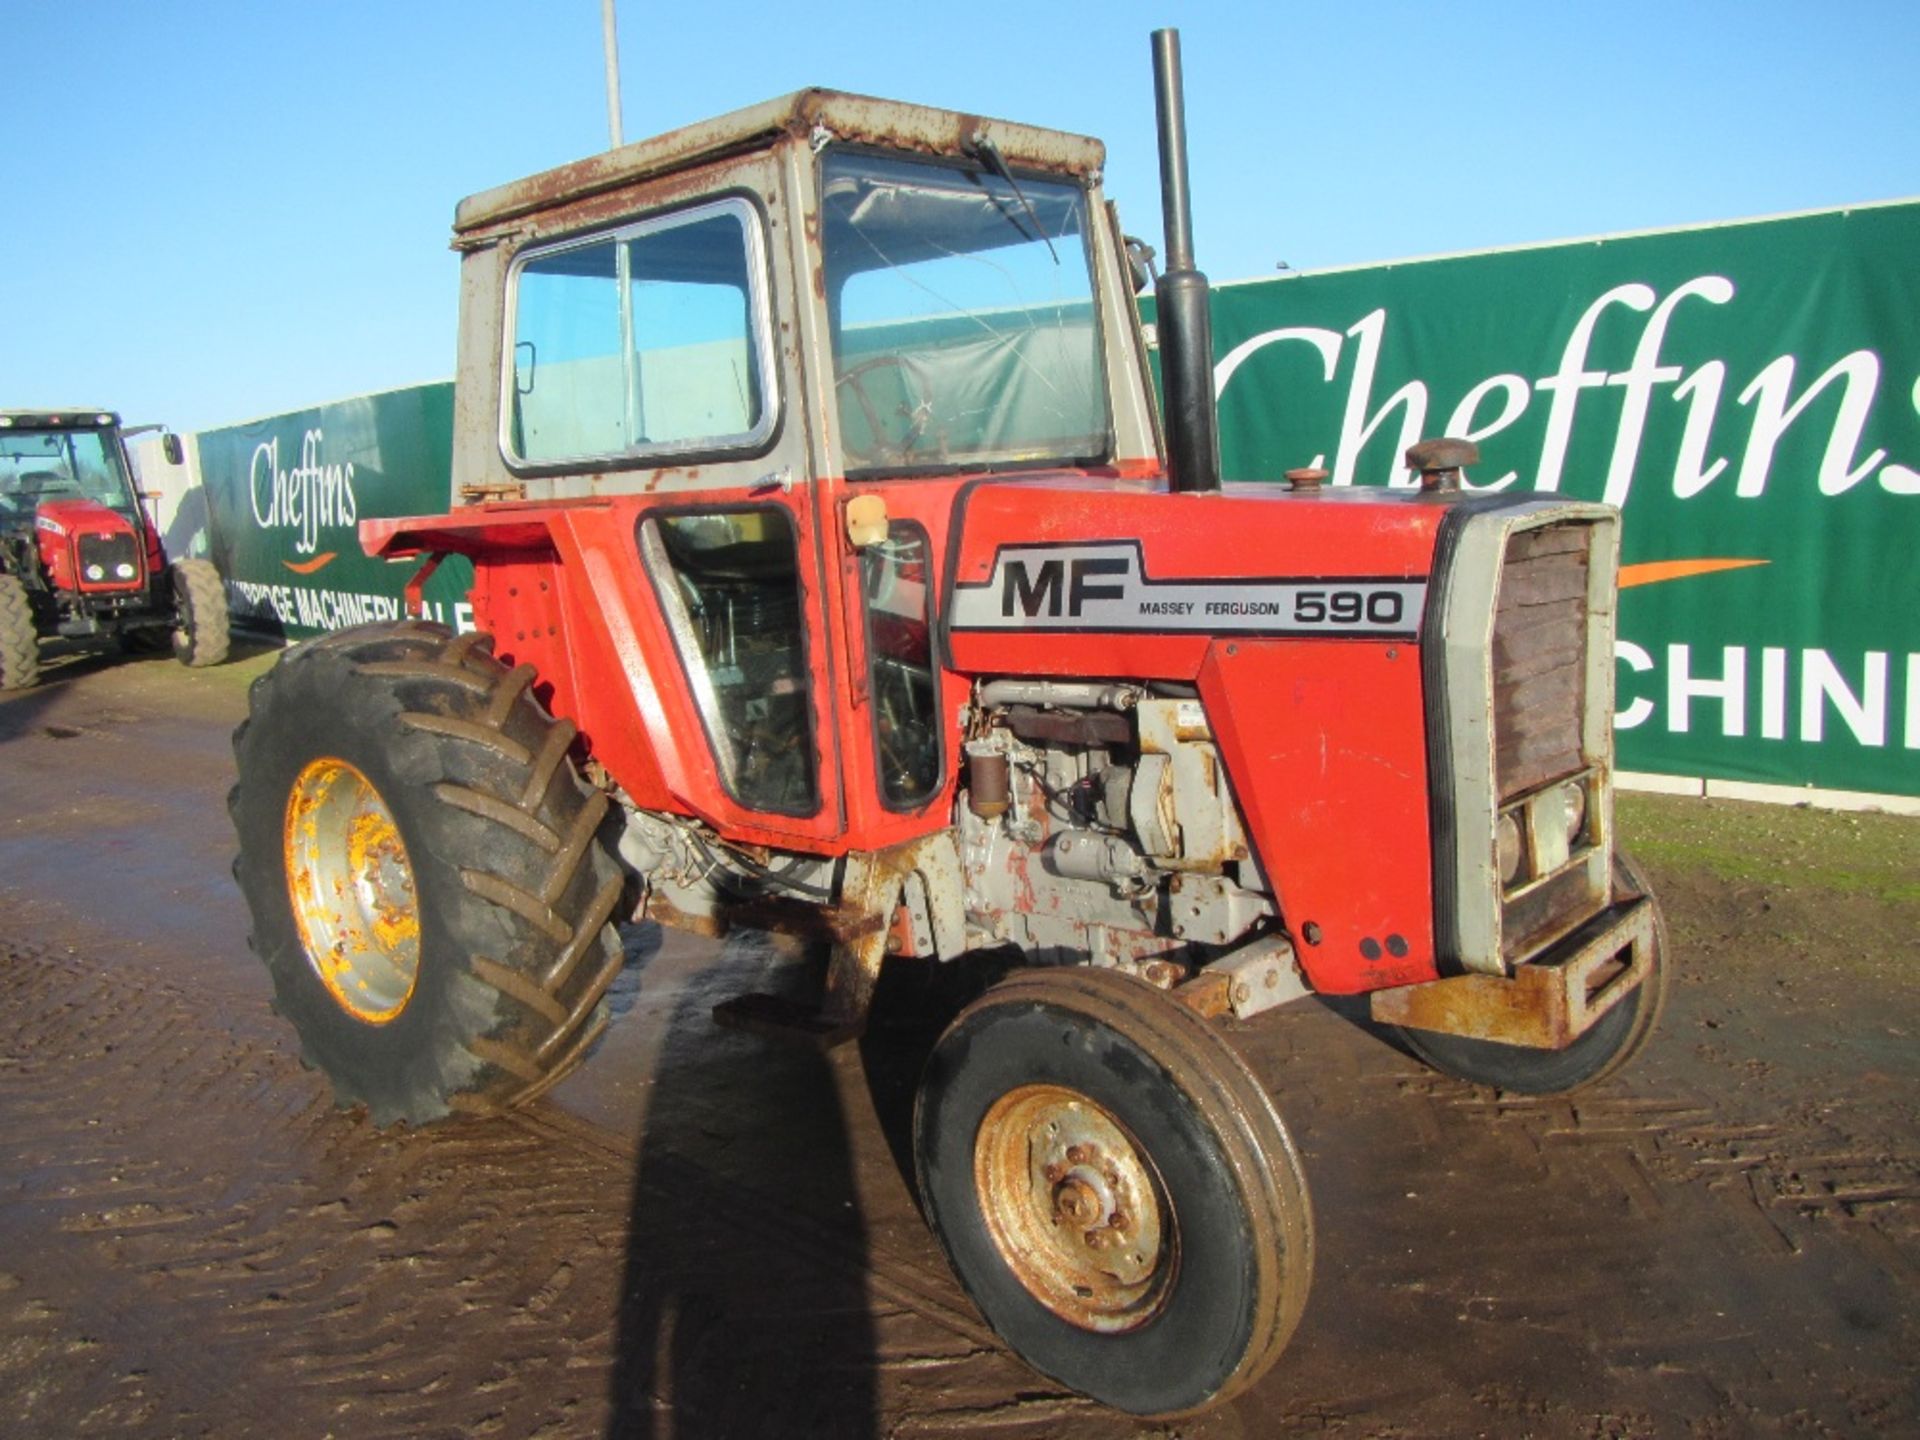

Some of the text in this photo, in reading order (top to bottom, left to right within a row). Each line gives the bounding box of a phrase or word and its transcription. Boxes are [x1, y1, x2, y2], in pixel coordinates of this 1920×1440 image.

[250, 428, 356, 553] Cheffins
[1001, 557, 1130, 617] MF
[1139, 591, 1403, 624] MASSEY FERGUSON 590
